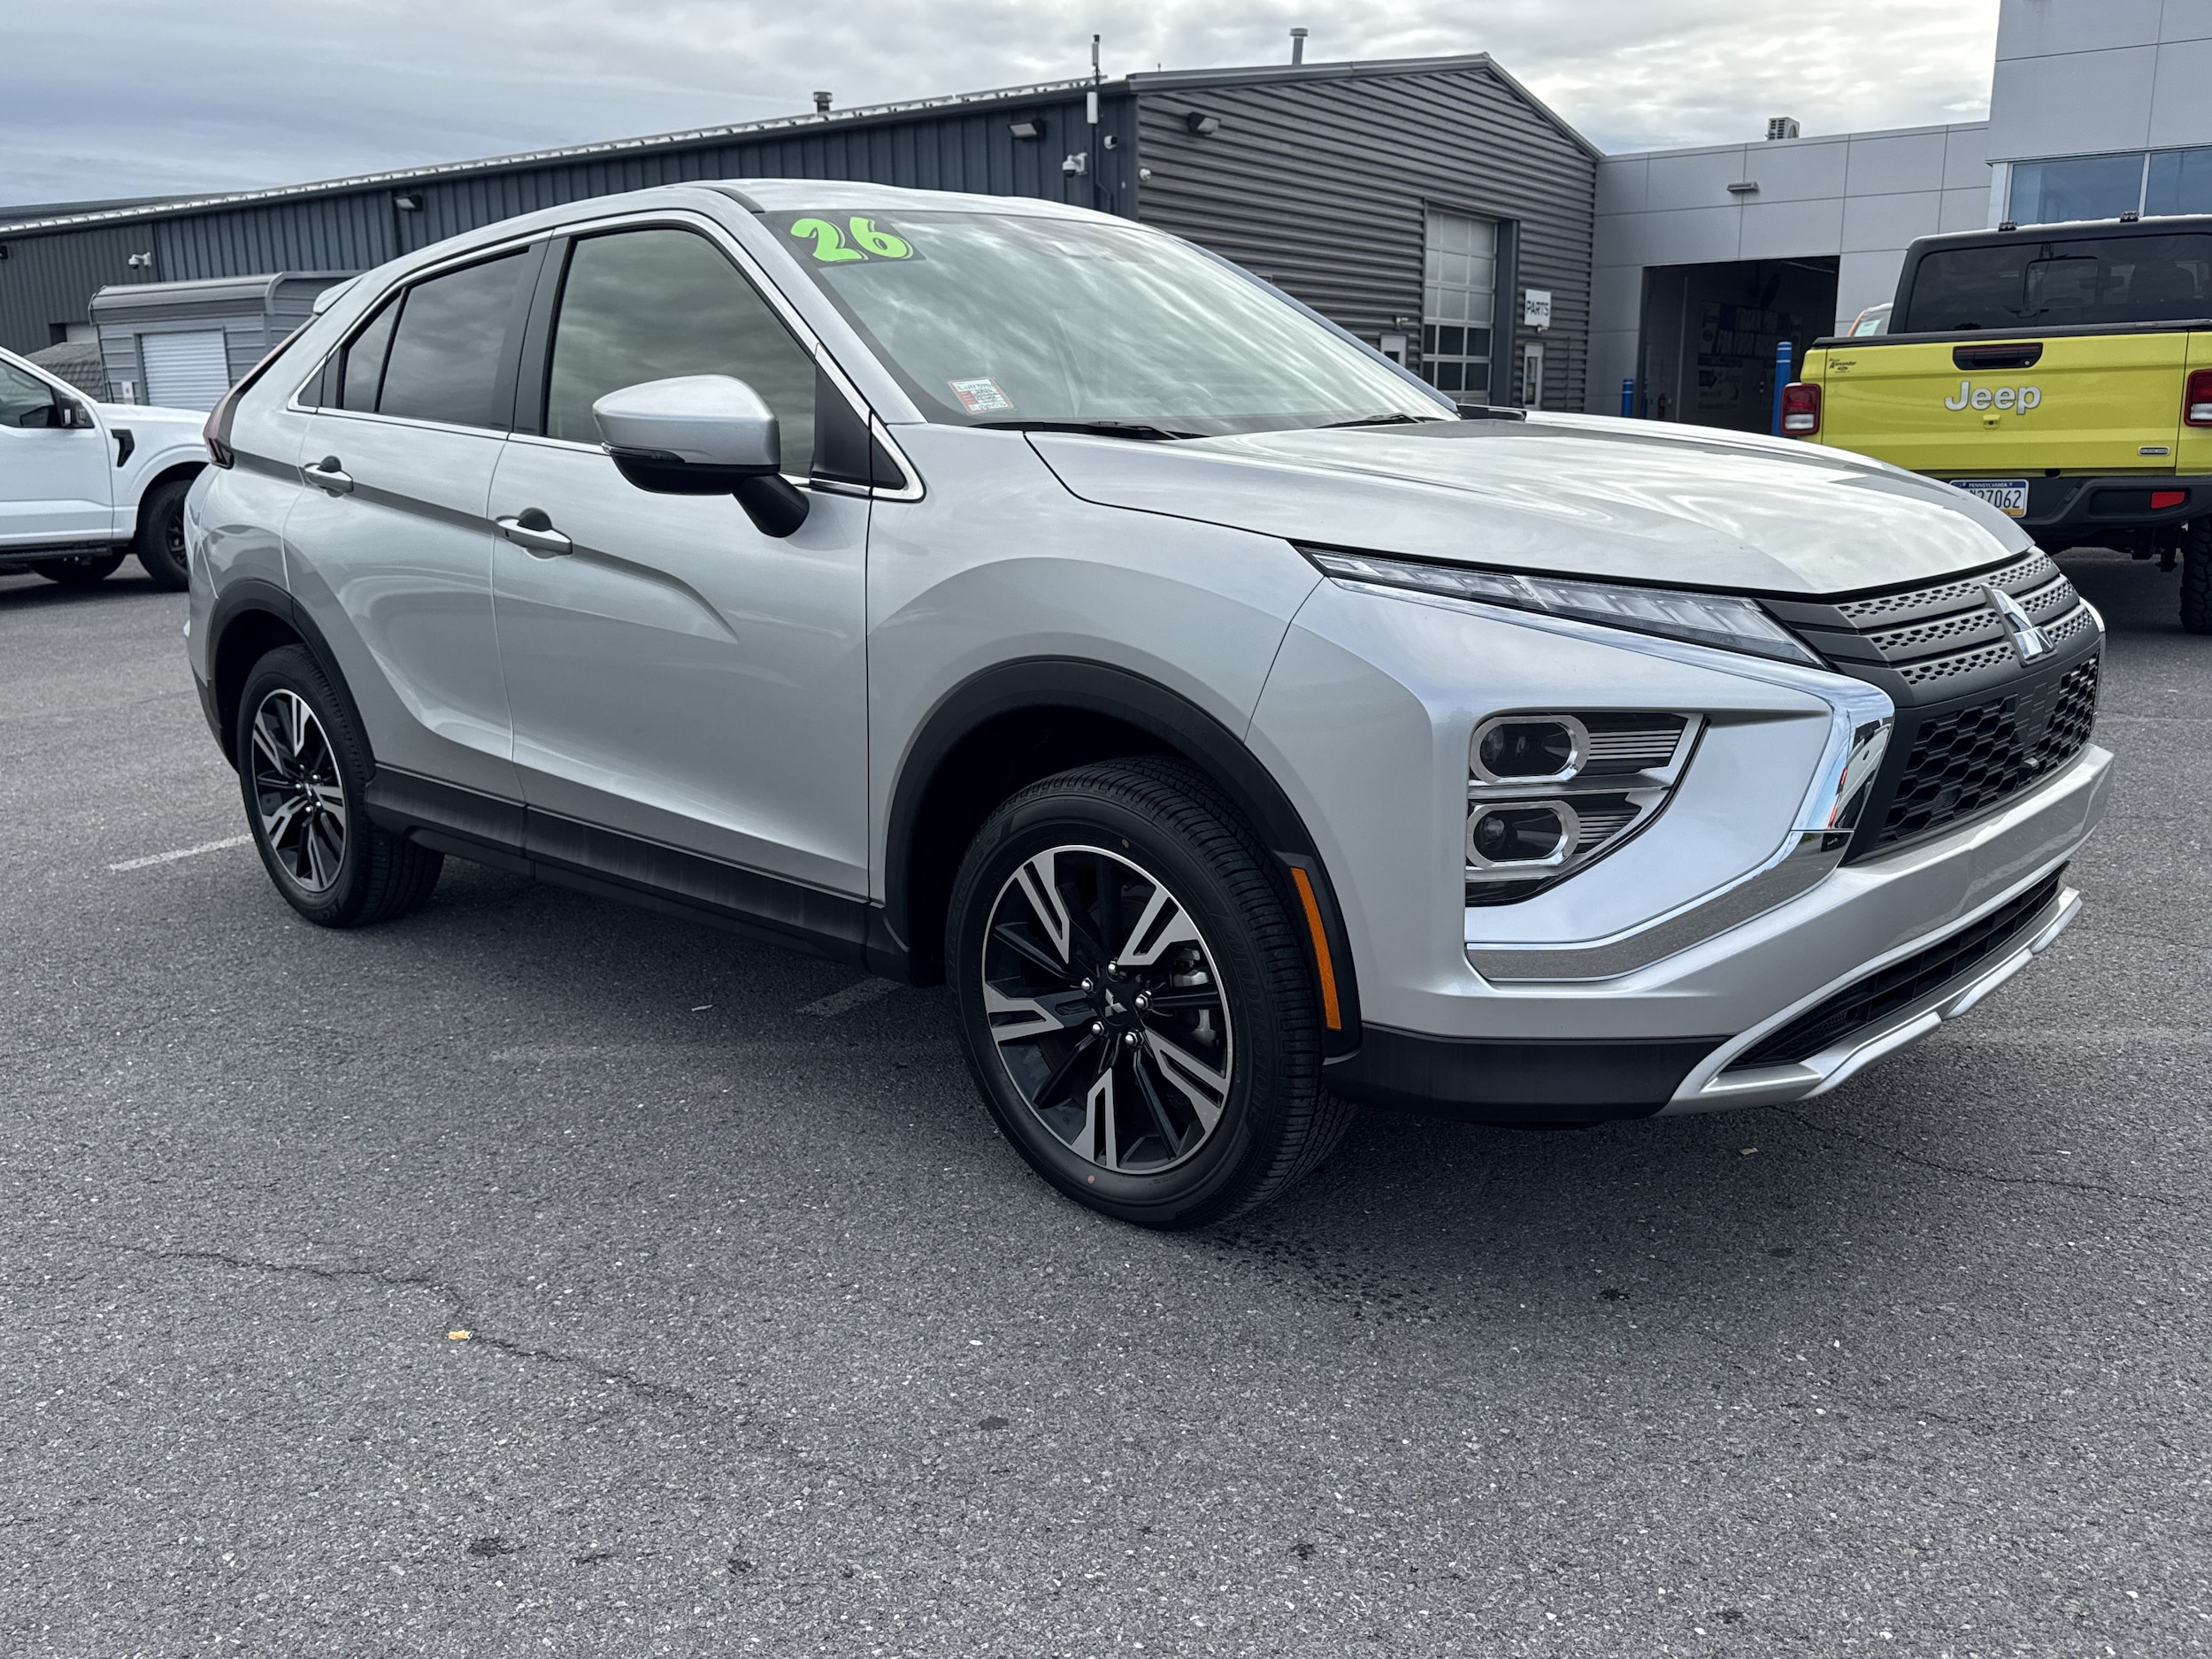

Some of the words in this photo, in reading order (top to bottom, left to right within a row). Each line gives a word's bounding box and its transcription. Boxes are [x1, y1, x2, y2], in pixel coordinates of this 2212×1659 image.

[789, 216, 914, 263] 26
[1525, 300, 1549, 317] PARTS
[1944, 380, 2042, 416] Jeep
[1970, 489, 2022, 509] 7062
